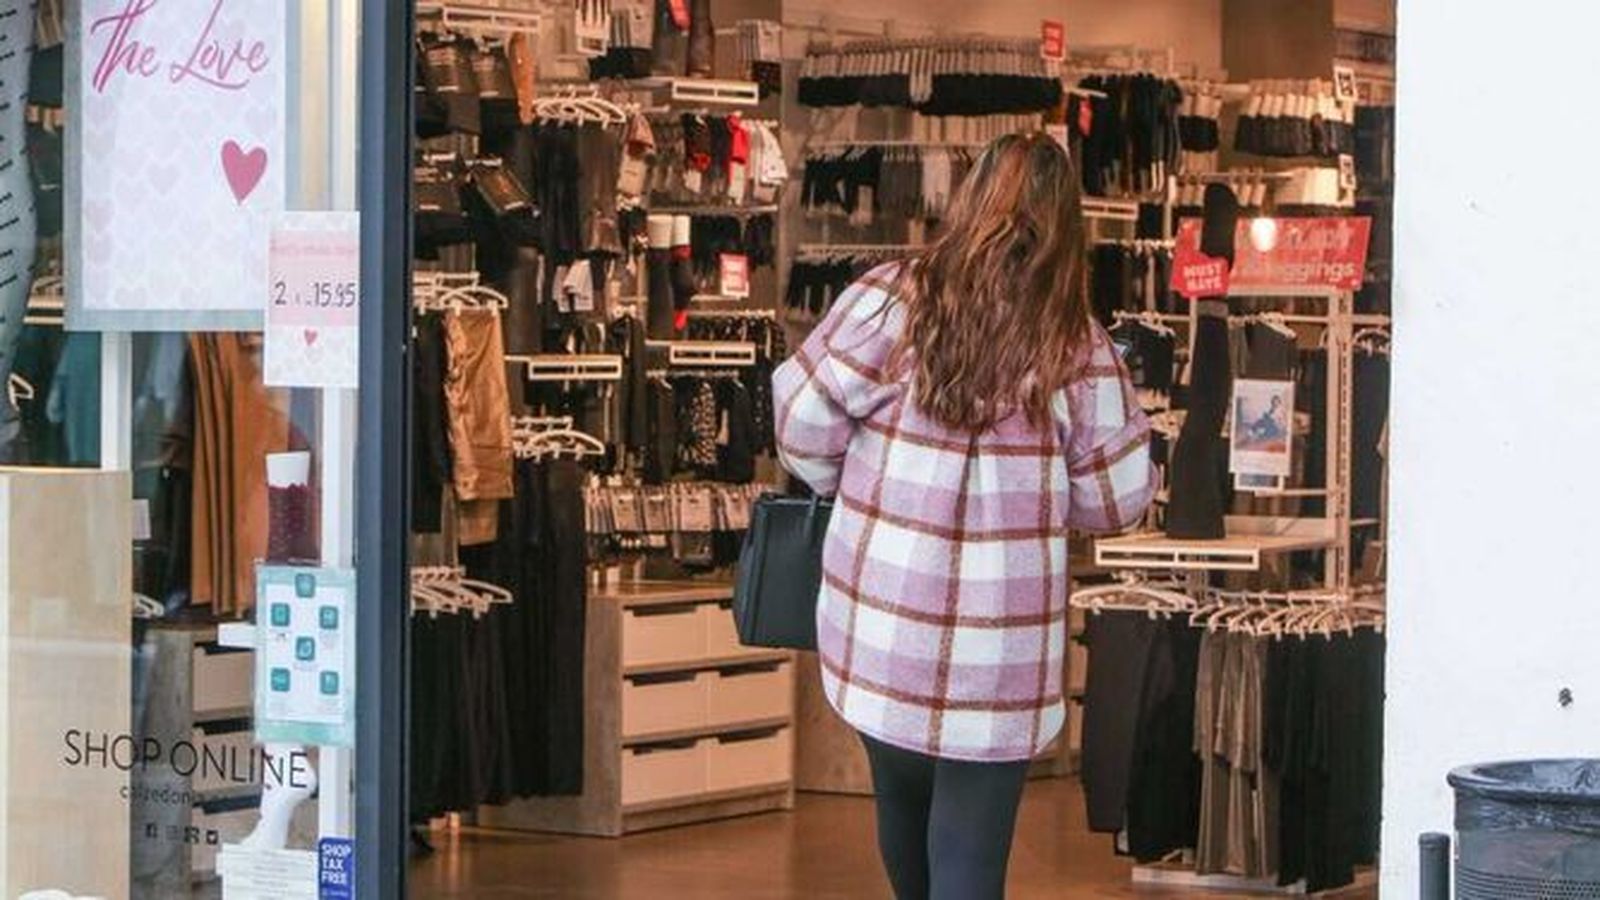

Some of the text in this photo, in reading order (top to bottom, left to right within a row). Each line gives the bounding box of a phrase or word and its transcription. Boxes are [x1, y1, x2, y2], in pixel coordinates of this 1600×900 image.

[169, 0, 269, 90] Love
[1183, 263, 1222, 277] MUST
[274, 280, 287, 305] 2
[64, 728, 309, 789] SHOP ONLINE
[321, 843, 352, 857] SHOP
[322, 858, 344, 870] TAX
[321, 870, 348, 884] FREE
